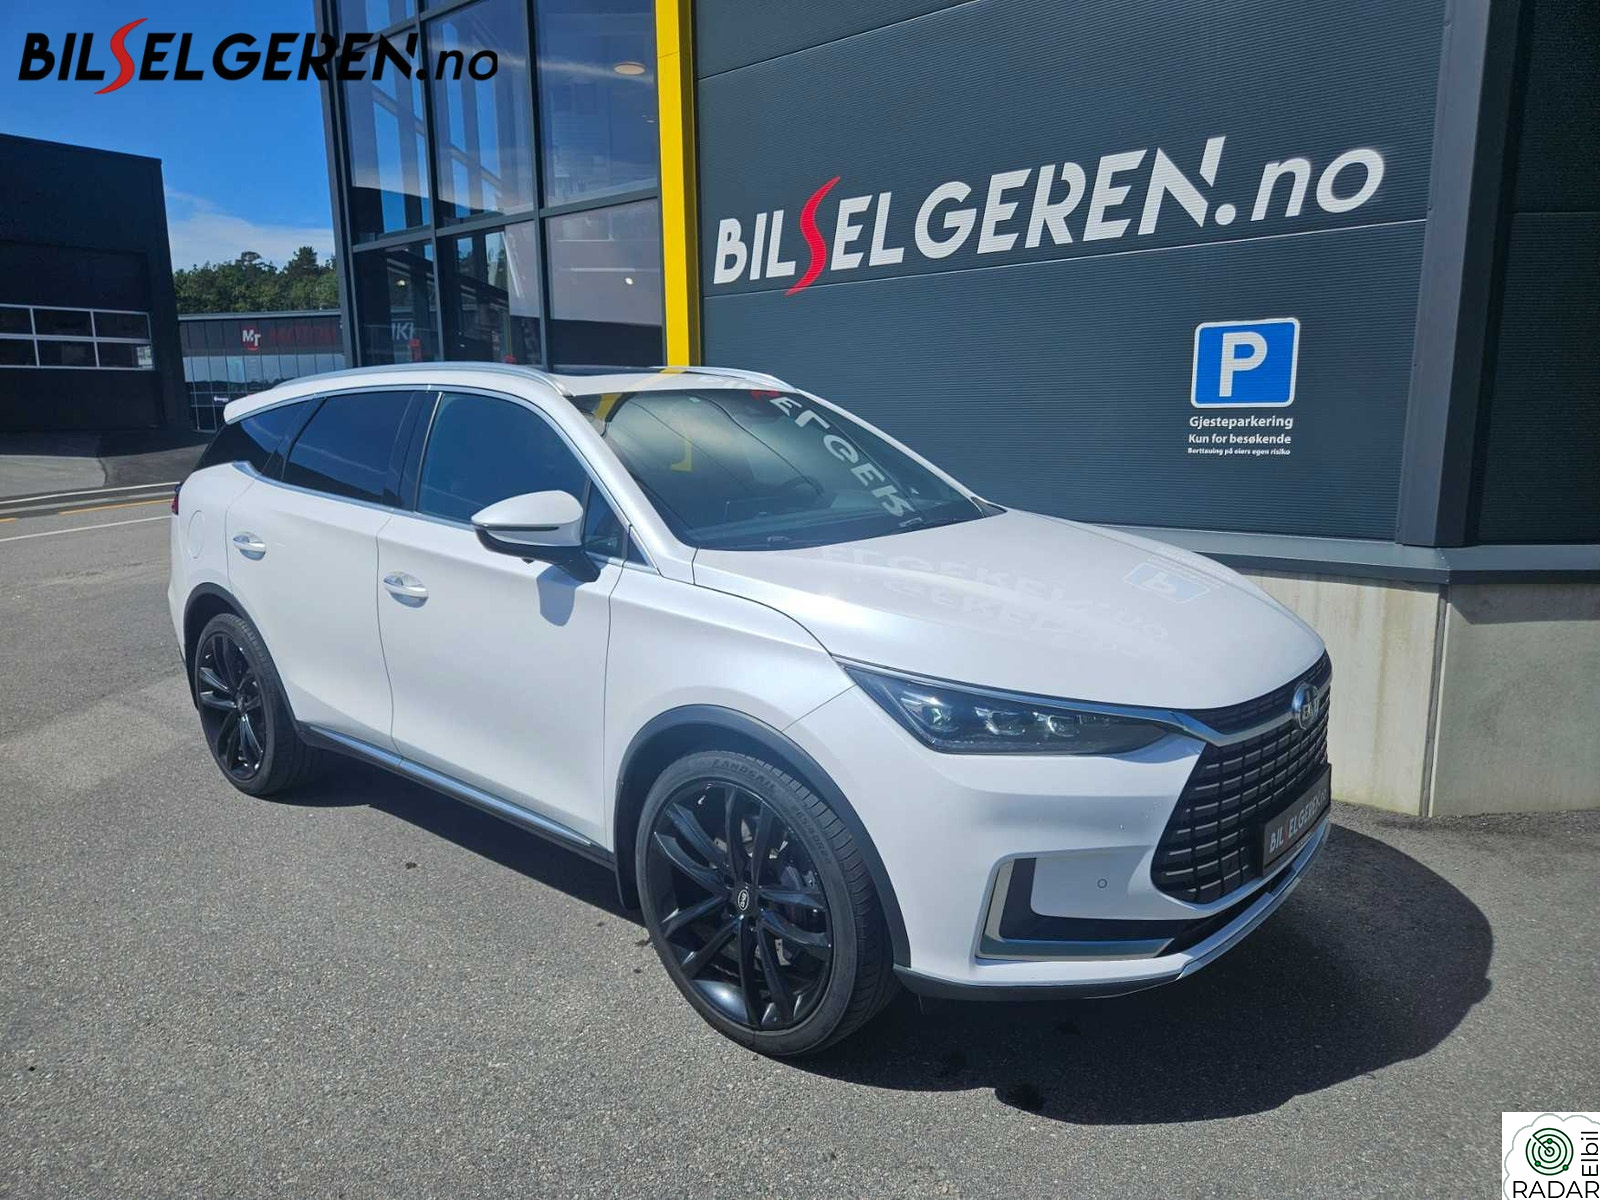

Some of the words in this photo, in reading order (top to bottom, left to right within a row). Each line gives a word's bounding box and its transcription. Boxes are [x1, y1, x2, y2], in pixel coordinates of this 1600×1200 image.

[1219, 331, 1268, 397] P
[1189, 415, 1294, 429] Gjesteparkering
[1188, 433, 1209, 444] Kun
[1211, 433, 1228, 444] for
[1229, 433, 1292, 444] besøkende
[1270, 447, 1291, 456] risiko
